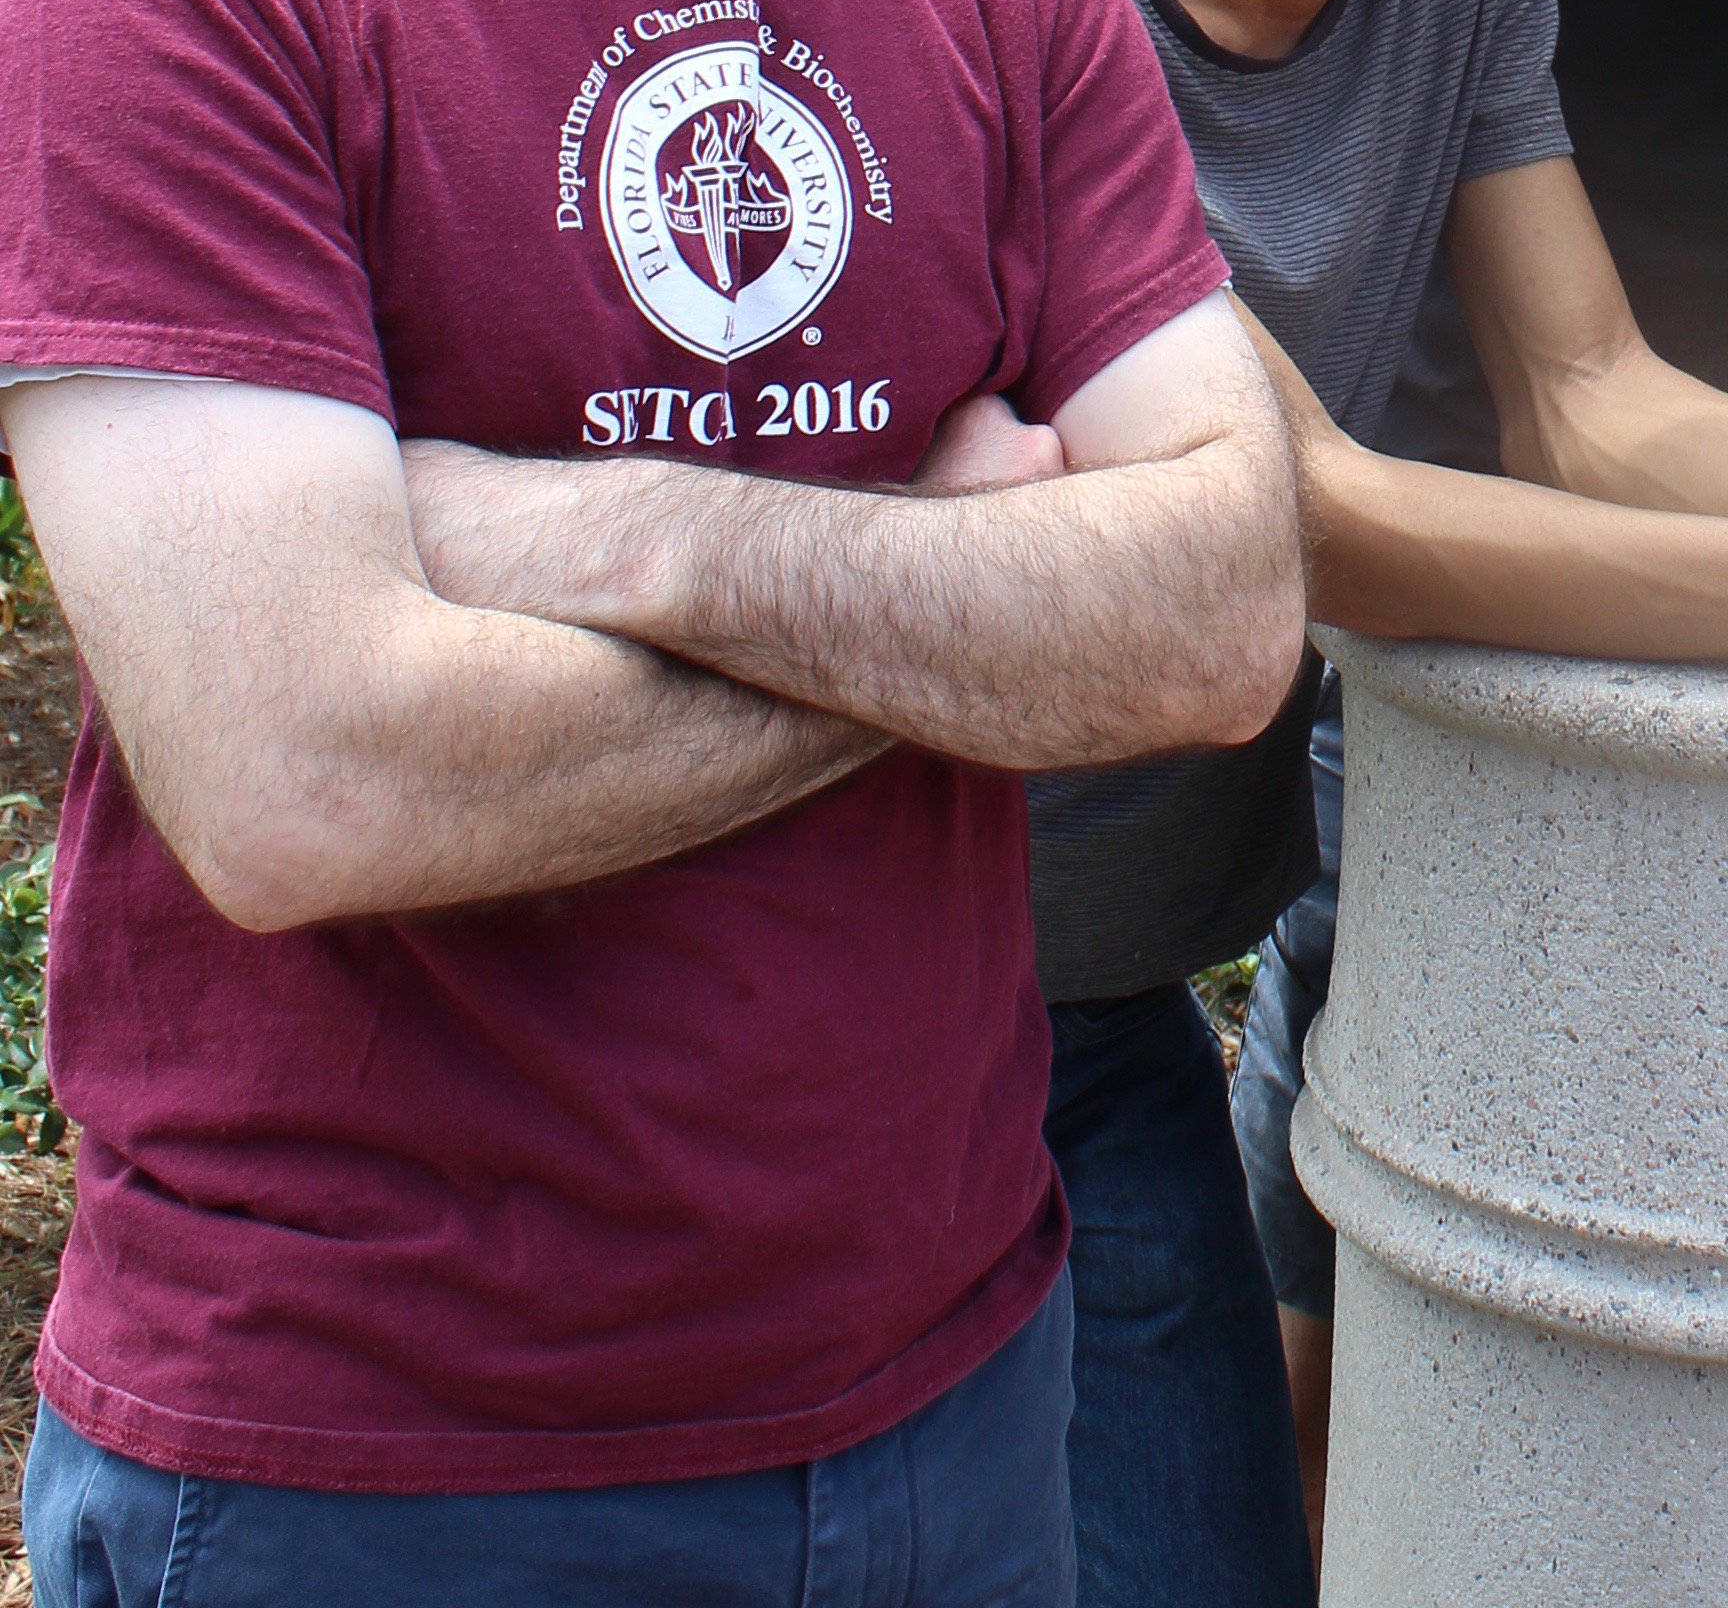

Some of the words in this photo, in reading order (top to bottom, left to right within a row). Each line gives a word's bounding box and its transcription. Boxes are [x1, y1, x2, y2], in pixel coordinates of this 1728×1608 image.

[556, 59, 608, 231] Department
[602, 27, 635, 67] of
[758, 25, 778, 55] &
[780, 39, 893, 225] Biochemistry
[623, 124, 671, 281] FLORIDA
[649, 62, 753, 119] STATE
[758, 98, 831, 282] NIVERSITY
[740, 209, 782, 224] MORES
[583, 387, 737, 446] SETCA
[755, 378, 893, 437] 2016
